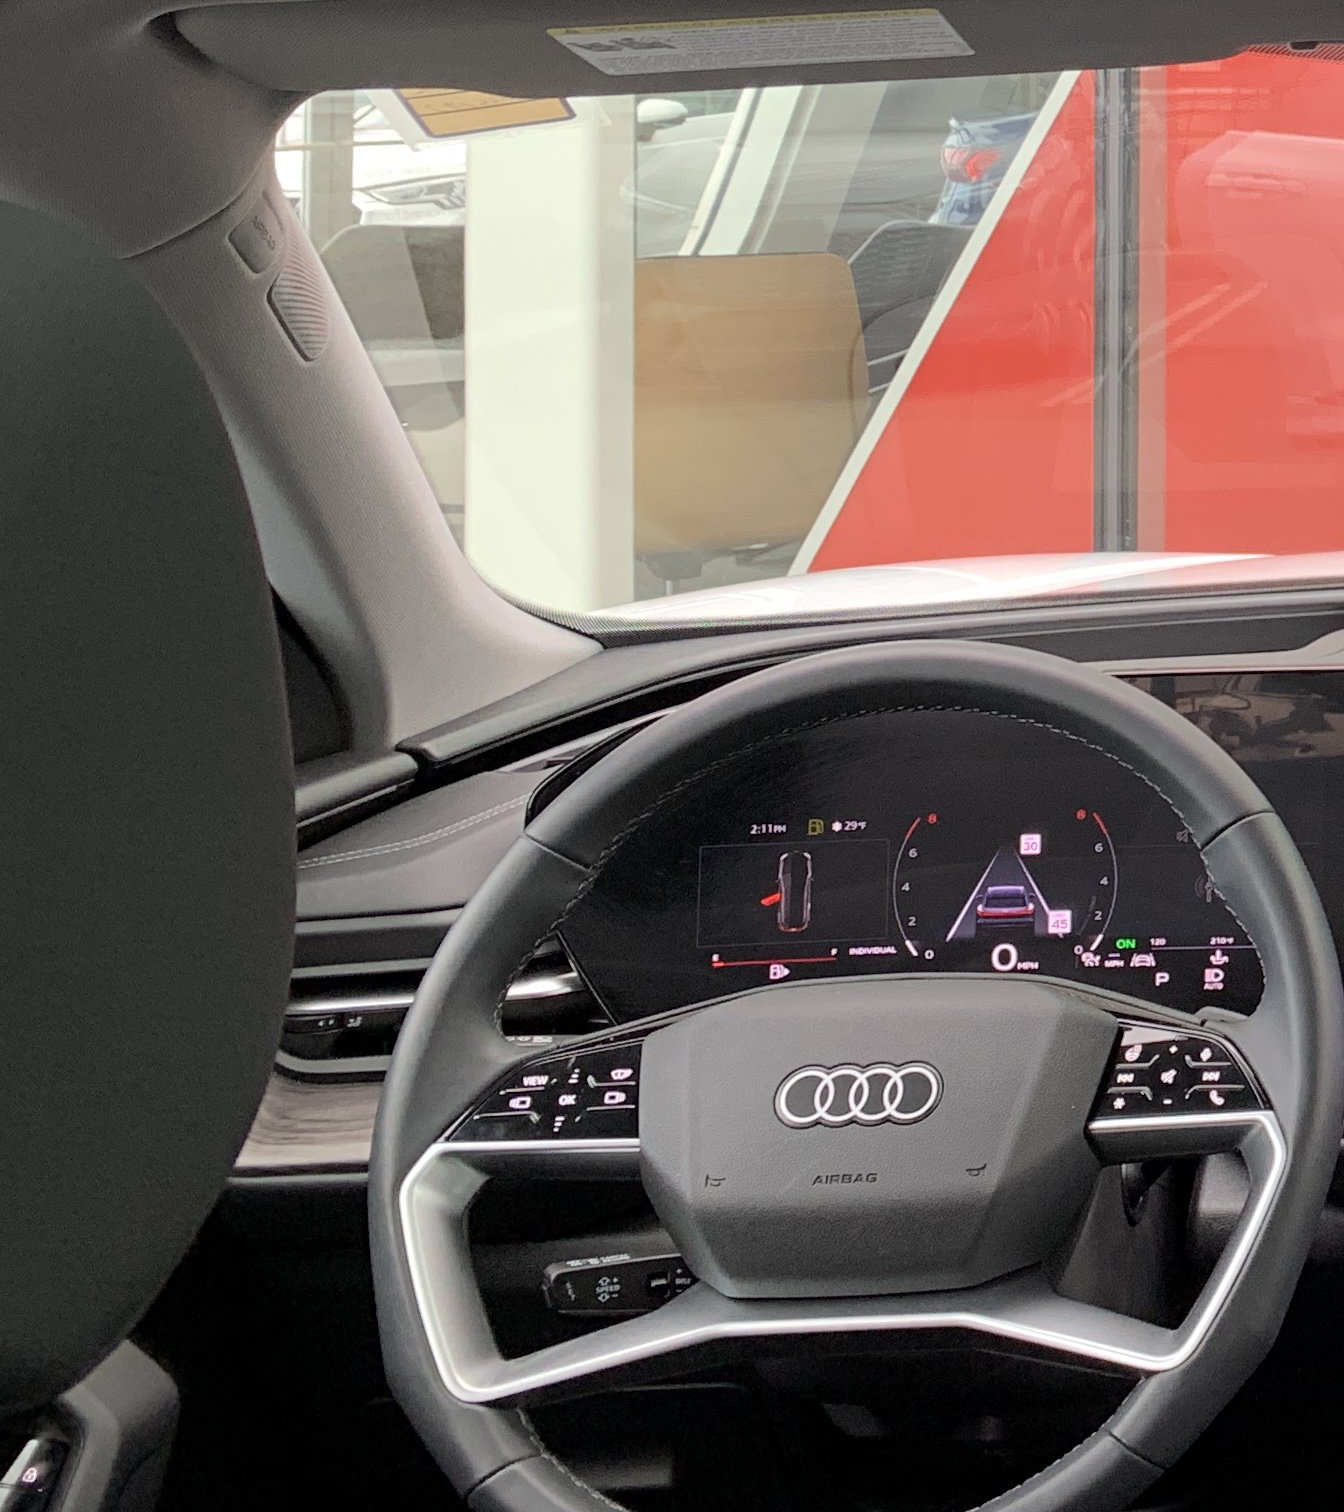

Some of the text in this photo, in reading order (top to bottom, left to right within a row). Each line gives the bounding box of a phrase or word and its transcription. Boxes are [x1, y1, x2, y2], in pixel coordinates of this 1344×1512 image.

[1024, 841, 1038, 851] 30
[1094, 843, 1104, 853] 6
[908, 848, 918, 858] 6
[1100, 876, 1109, 886] 4
[901, 882, 910, 892] 4
[1094, 910, 1103, 921] 2
[908, 916, 917, 927] 2
[1052, 918, 1068, 930] 45
[1115, 938, 1136, 949] ON
[849, 946, 897, 956] INDIVIDUAL
[924, 949, 934, 960] 0
[1074, 945, 1083, 956] 0
[991, 943, 1039, 972] 0 MPH
[1155, 972, 1170, 986] P
[522, 1075, 549, 1086] VIEW
[558, 1094, 577, 1106] OK
[812, 1172, 878, 1186] AIRBAG
